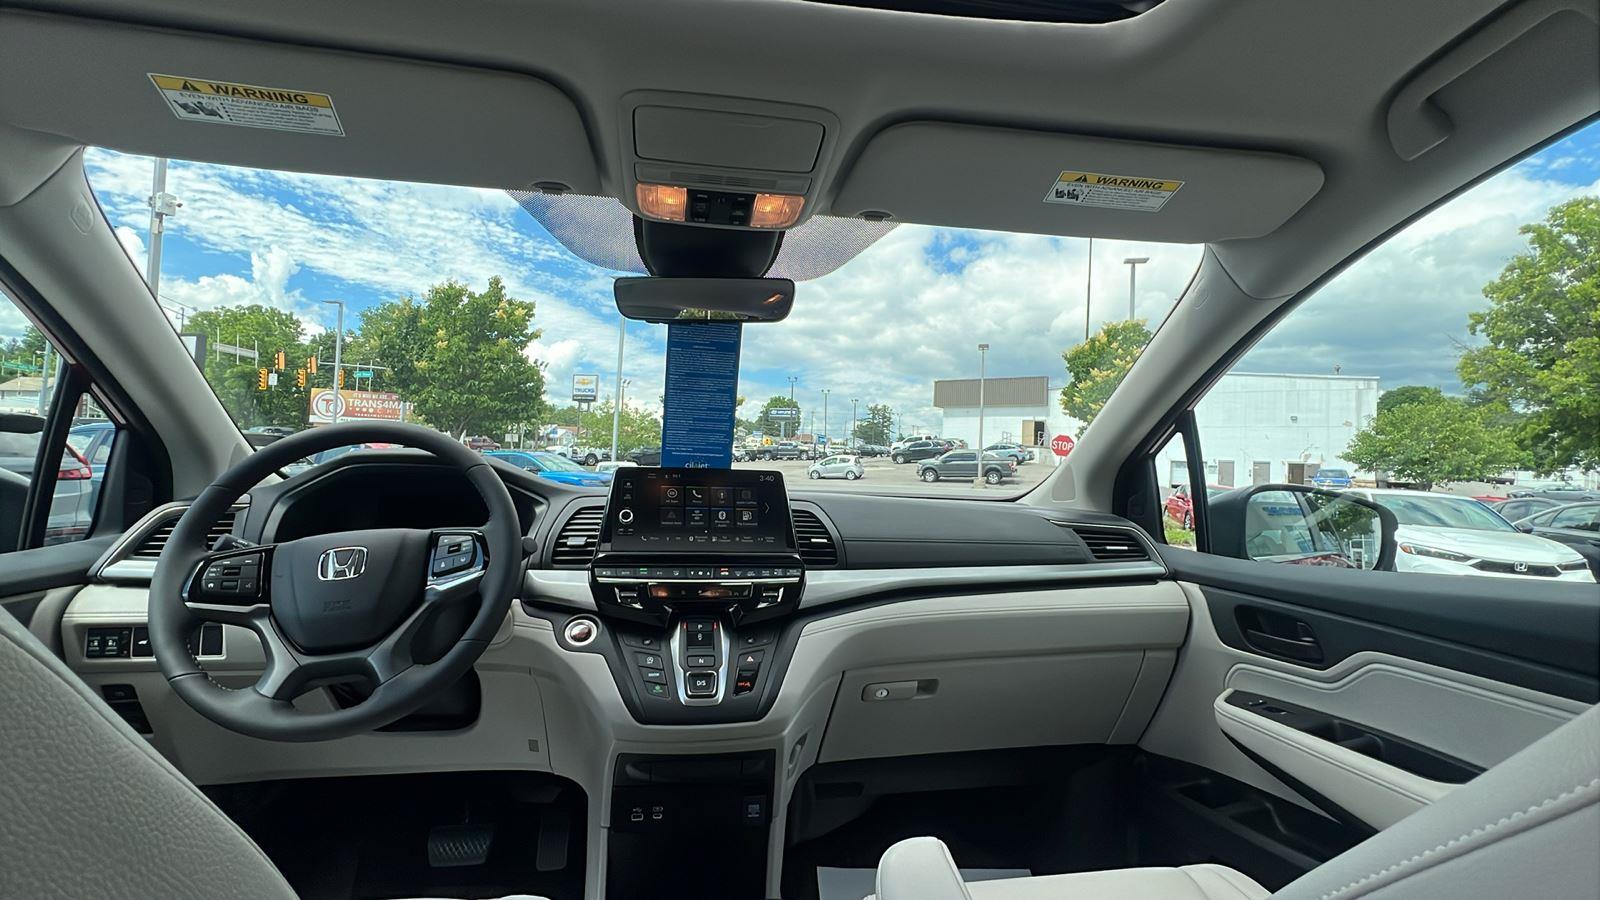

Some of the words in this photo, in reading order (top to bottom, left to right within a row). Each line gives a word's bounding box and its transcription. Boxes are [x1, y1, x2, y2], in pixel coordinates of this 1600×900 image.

[208, 83, 308, 104] WARNING
[1096, 176, 1164, 189] WARNING
[1052, 440, 1074, 451] STOP
[759, 475, 775, 483] 3:40
